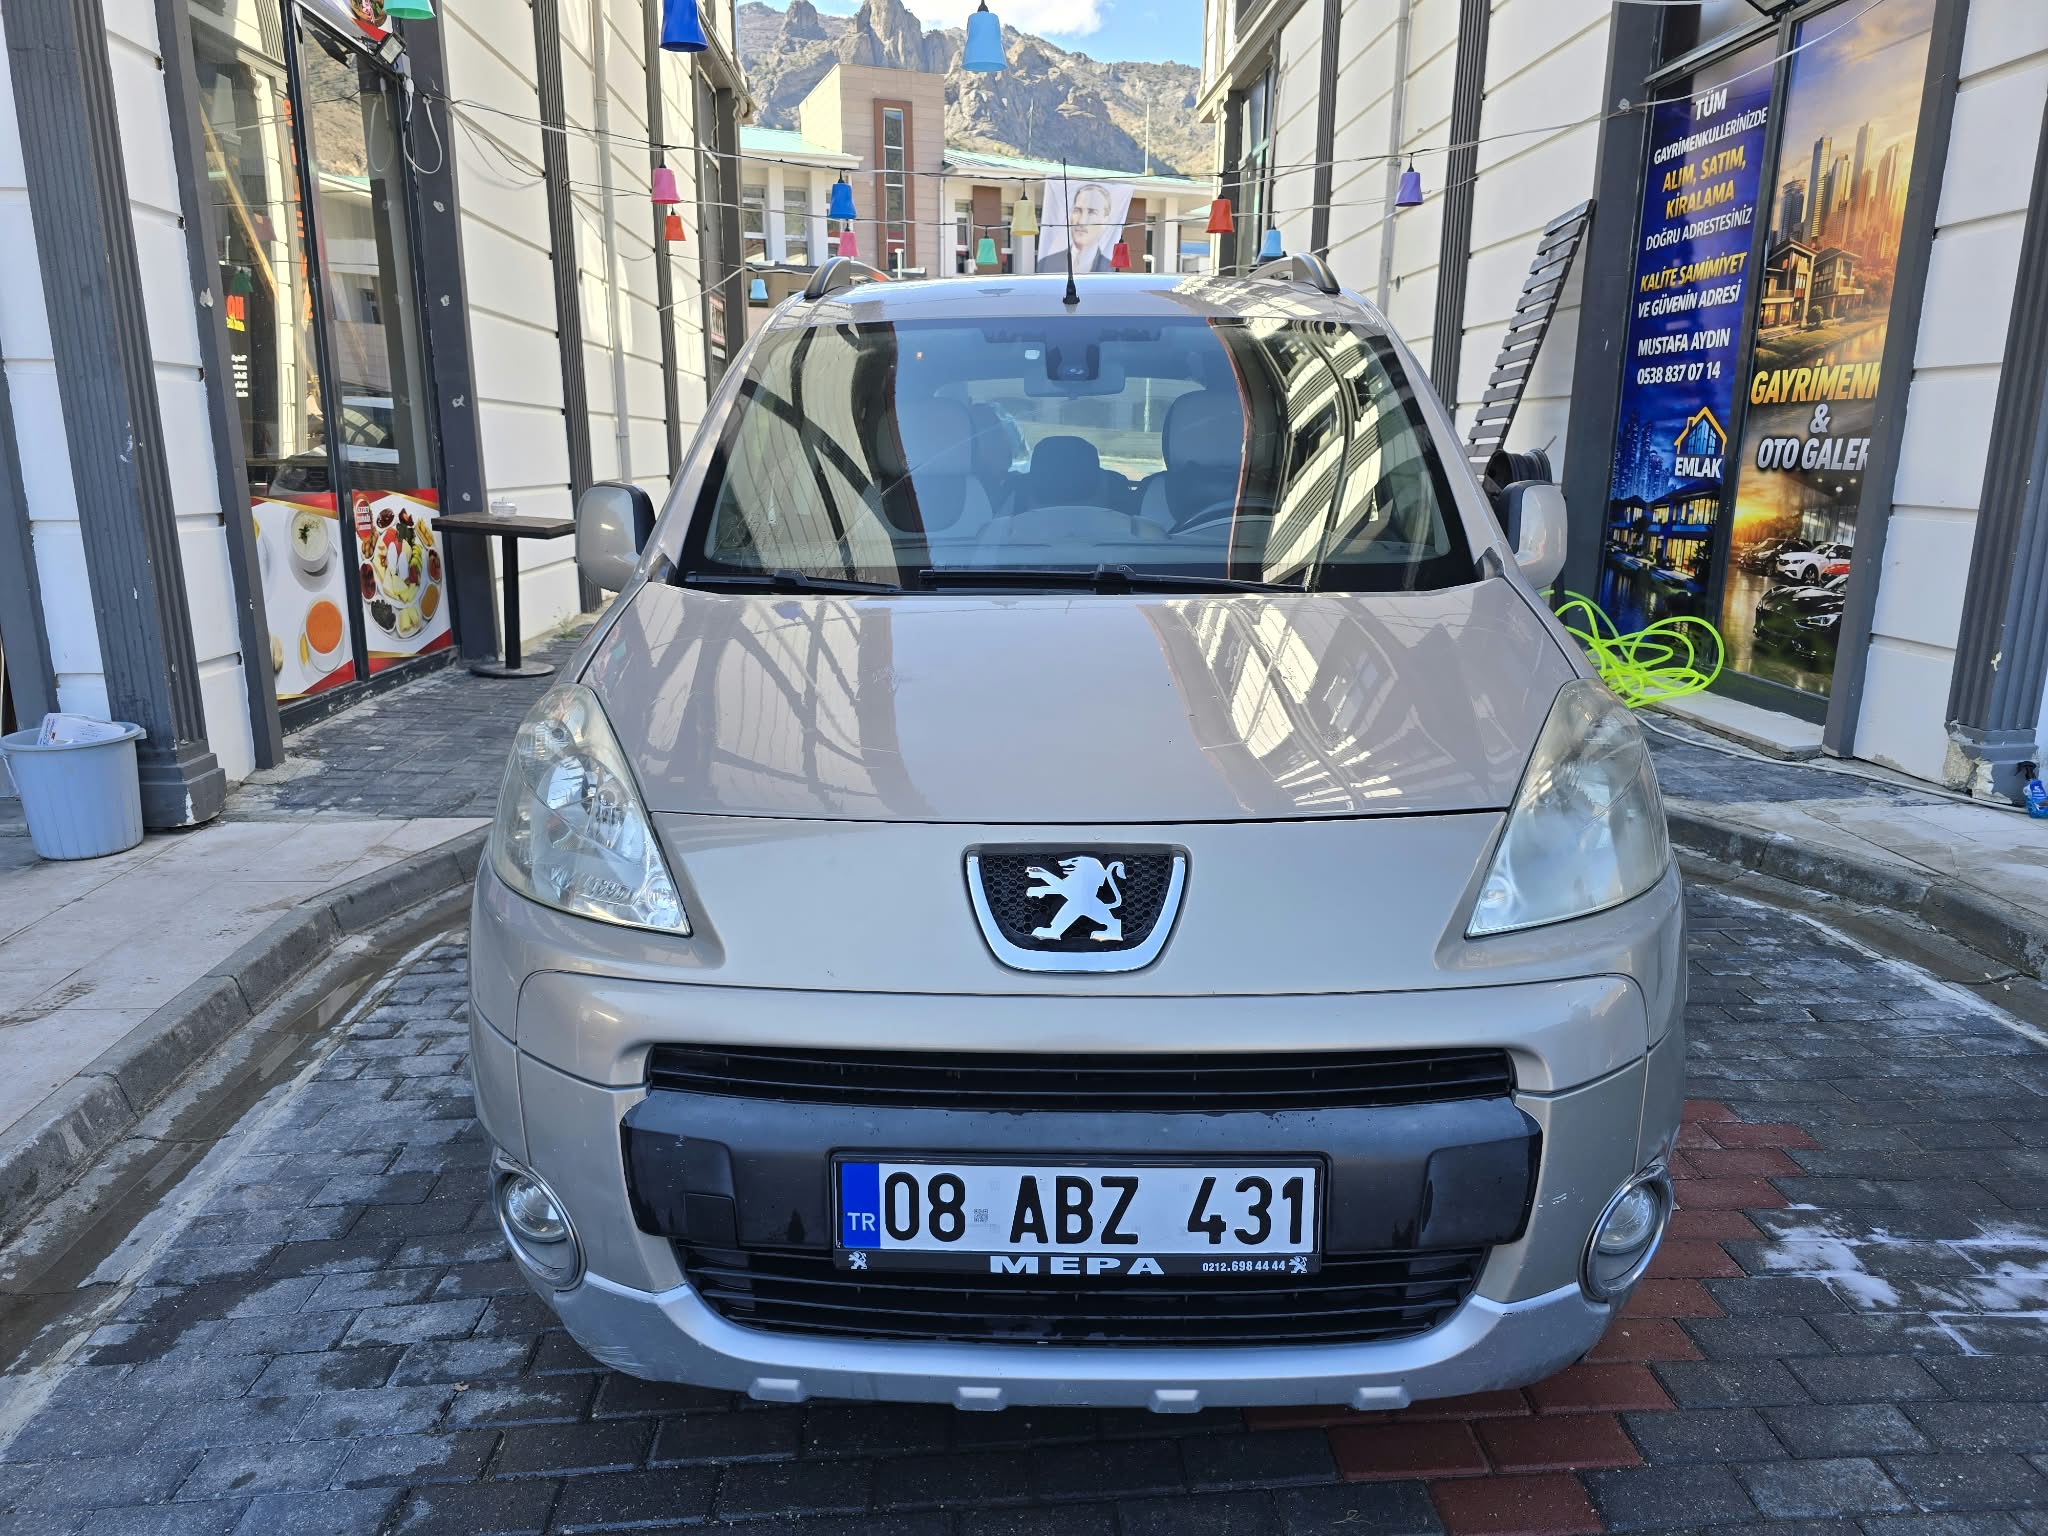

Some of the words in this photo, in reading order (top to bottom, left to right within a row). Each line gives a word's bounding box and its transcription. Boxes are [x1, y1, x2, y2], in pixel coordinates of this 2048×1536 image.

[1695, 88, 1728, 121] TÜM
[1653, 106, 1768, 165] GAYRİMENKULLERİNİZDE
[1662, 163, 1697, 193] ALIM,
[1700, 145, 1747, 180] SATIM,
[1665, 180, 1735, 220] KİRALAMA
[1645, 227, 1681, 251] DOĞRU
[1681, 206, 1753, 240] ADRESTESİNİZ
[1639, 264, 1678, 293] KALİTE
[1678, 251, 1748, 286] SAMİMİYET
[1637, 302, 1650, 319] VE
[1651, 289, 1697, 317] GÜVENİN
[1698, 280, 1742, 308] ADRESİ
[1637, 333, 1689, 357] MUSTAFA
[1690, 328, 1731, 350] AYDIN
[1637, 367, 1663, 385] 0538
[1664, 365, 1685, 383] 837
[1687, 363, 1704, 381] 07
[1706, 361, 1721, 380] 14
[1810, 403, 1831, 434] &
[1674, 457, 1723, 478] EMLAK
[1757, 437, 1800, 469] OTO
[847, 1212, 876, 1231] TR
[884, 1171, 966, 1242] 08
[1009, 1175, 1139, 1245] ABZ
[1187, 1175, 1305, 1245] 431
[989, 1255, 1165, 1275] MEPA
